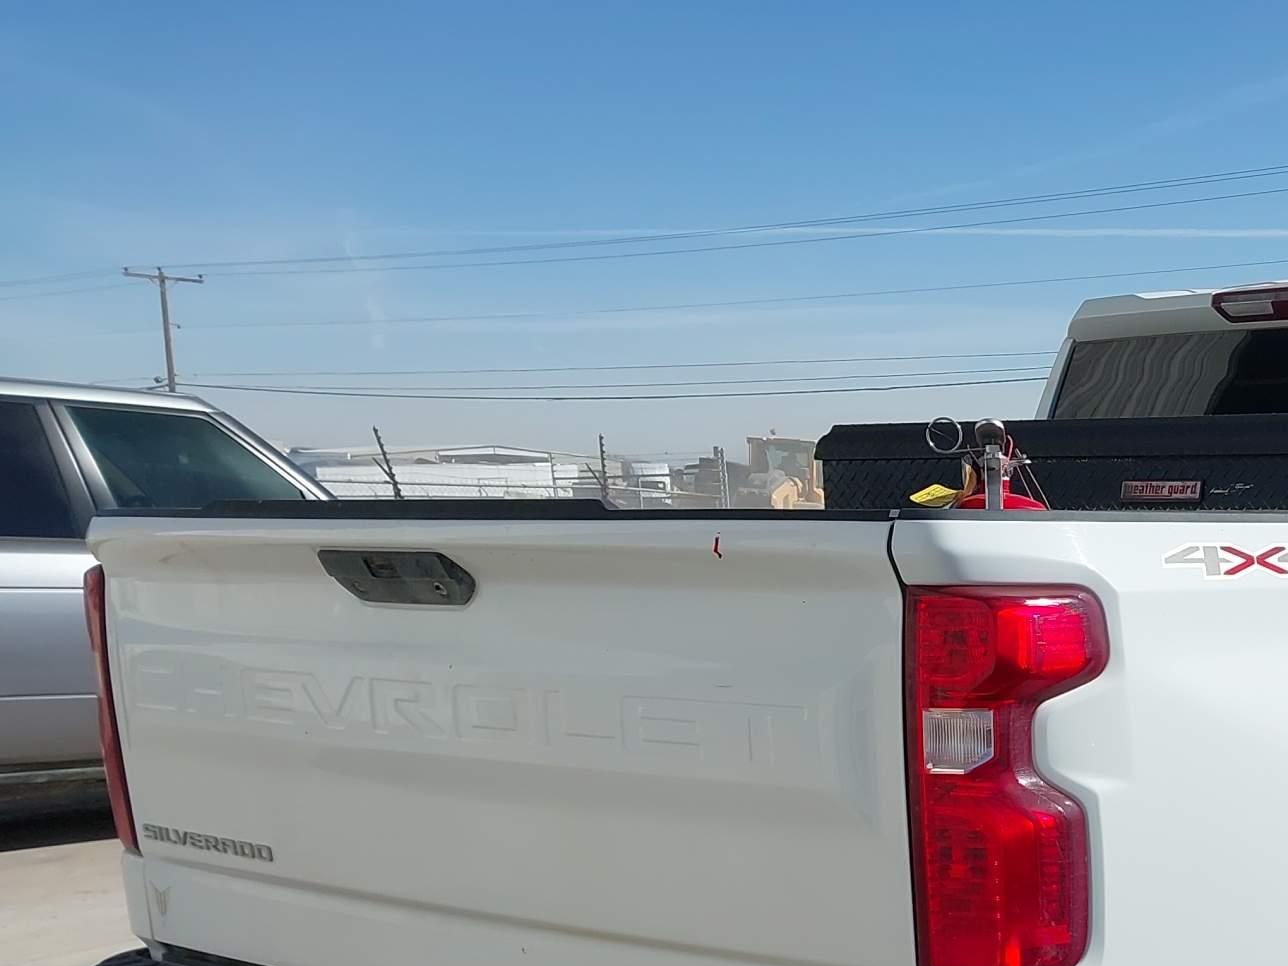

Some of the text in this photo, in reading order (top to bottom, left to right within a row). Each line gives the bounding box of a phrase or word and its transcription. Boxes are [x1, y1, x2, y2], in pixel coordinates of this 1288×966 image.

[1167, 482, 1198, 496] guard
[131, 648, 808, 765] CHEVROLET
[142, 822, 274, 863] SILVERADO
